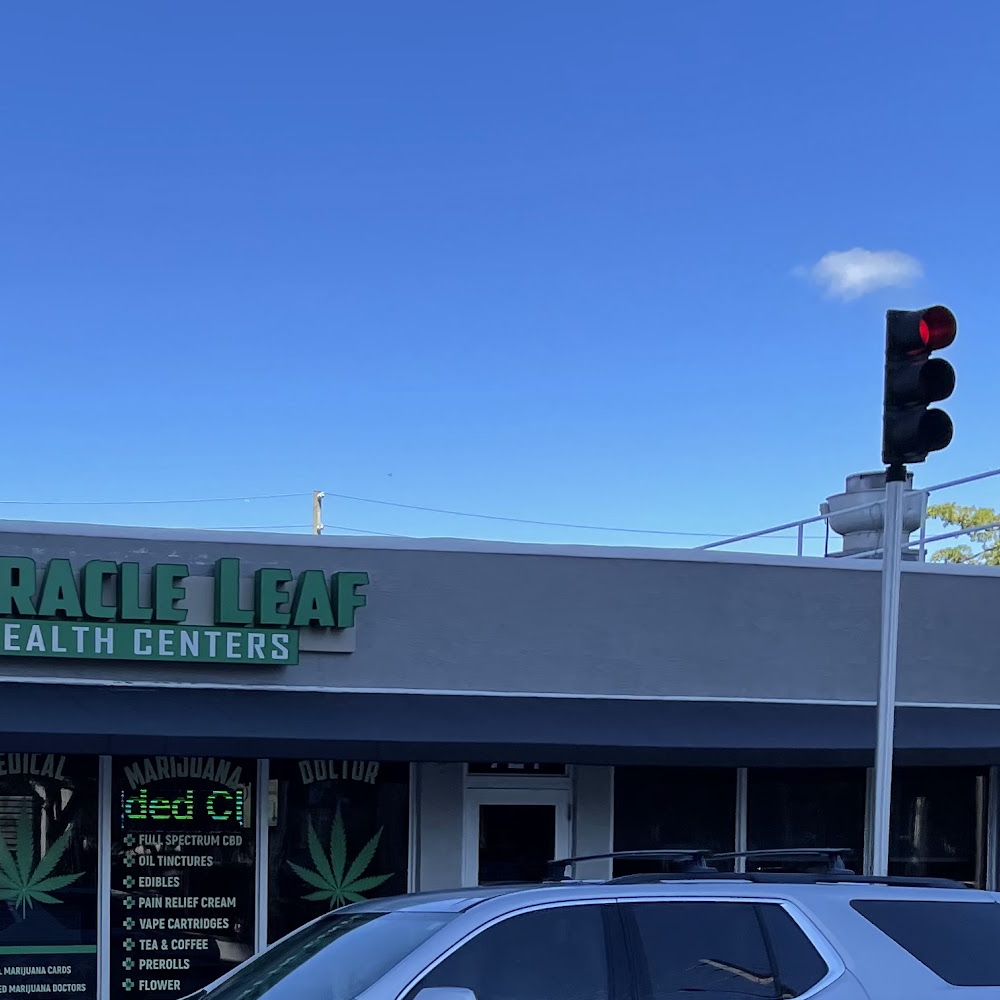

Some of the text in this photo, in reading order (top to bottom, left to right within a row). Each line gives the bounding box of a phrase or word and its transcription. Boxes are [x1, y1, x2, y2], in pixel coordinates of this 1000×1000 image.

[214, 558, 370, 629] LEAF
[133, 628, 291, 660] CENTERS
[123, 755, 243, 791] MARIJUANA
[139, 833, 243, 846] FULL SPECTRUM CBD
[138, 855, 214, 867] OIL TINCTURES
[138, 876, 180, 888] EDIBLES
[138, 897, 236, 909] PAIN RELIEF CREAM
[139, 917, 229, 930] VAPE CARTRIDGES
[139, 939, 209, 951] TEA & COFFEE
[138, 958, 190, 970] PREROLLS
[4, 966, 46, 976] MARIJUANA
[47, 965, 72, 975] CARDS
[8, 984, 51, 994] MARIJUANA
[52, 983, 86, 993] DOCTORS
[138, 979, 181, 991] FLOWER
